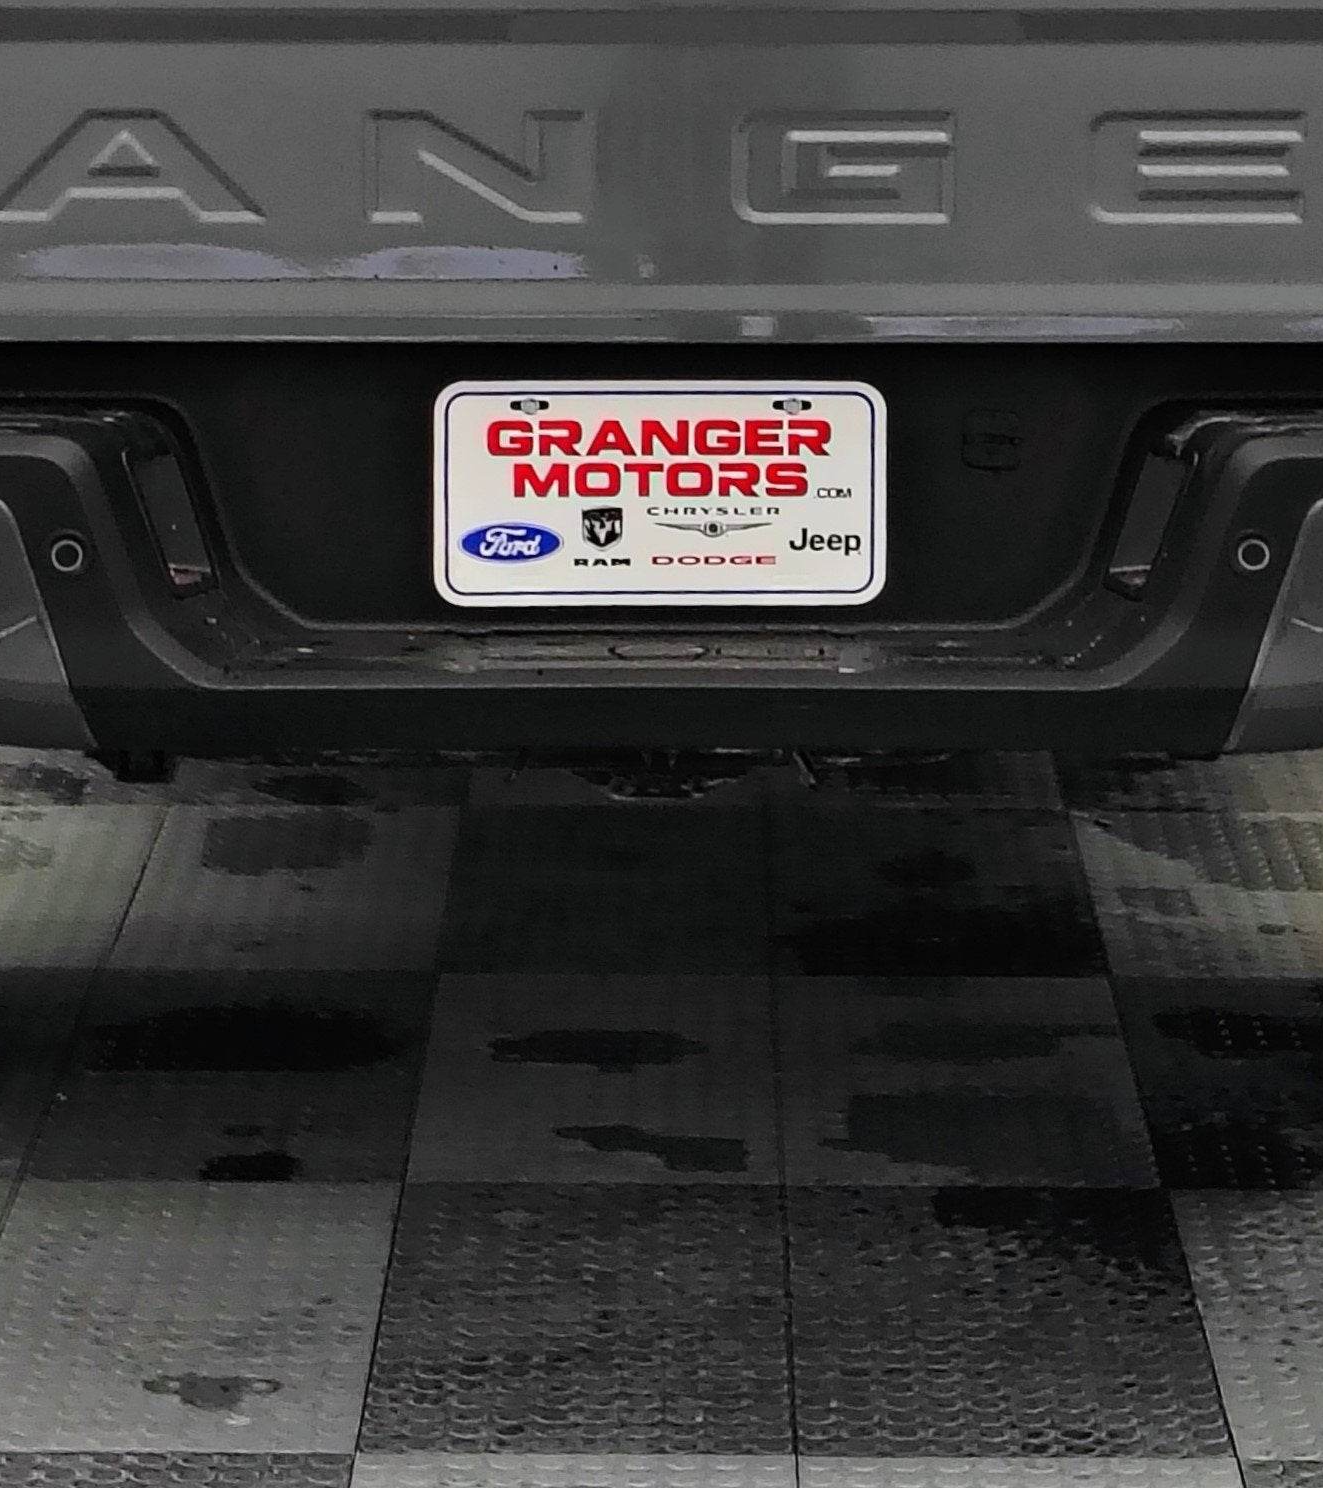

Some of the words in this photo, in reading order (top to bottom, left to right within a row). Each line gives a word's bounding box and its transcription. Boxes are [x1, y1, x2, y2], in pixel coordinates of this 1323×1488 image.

[487, 420, 831, 456] GRANGER
[513, 462, 808, 498] MOTORS
[646, 506, 780, 516] CHRYSLER
[479, 528, 541, 557] Ford
[789, 528, 861, 555] Jeep
[574, 557, 631, 567] RAM
[651, 555, 777, 566] DODGE
